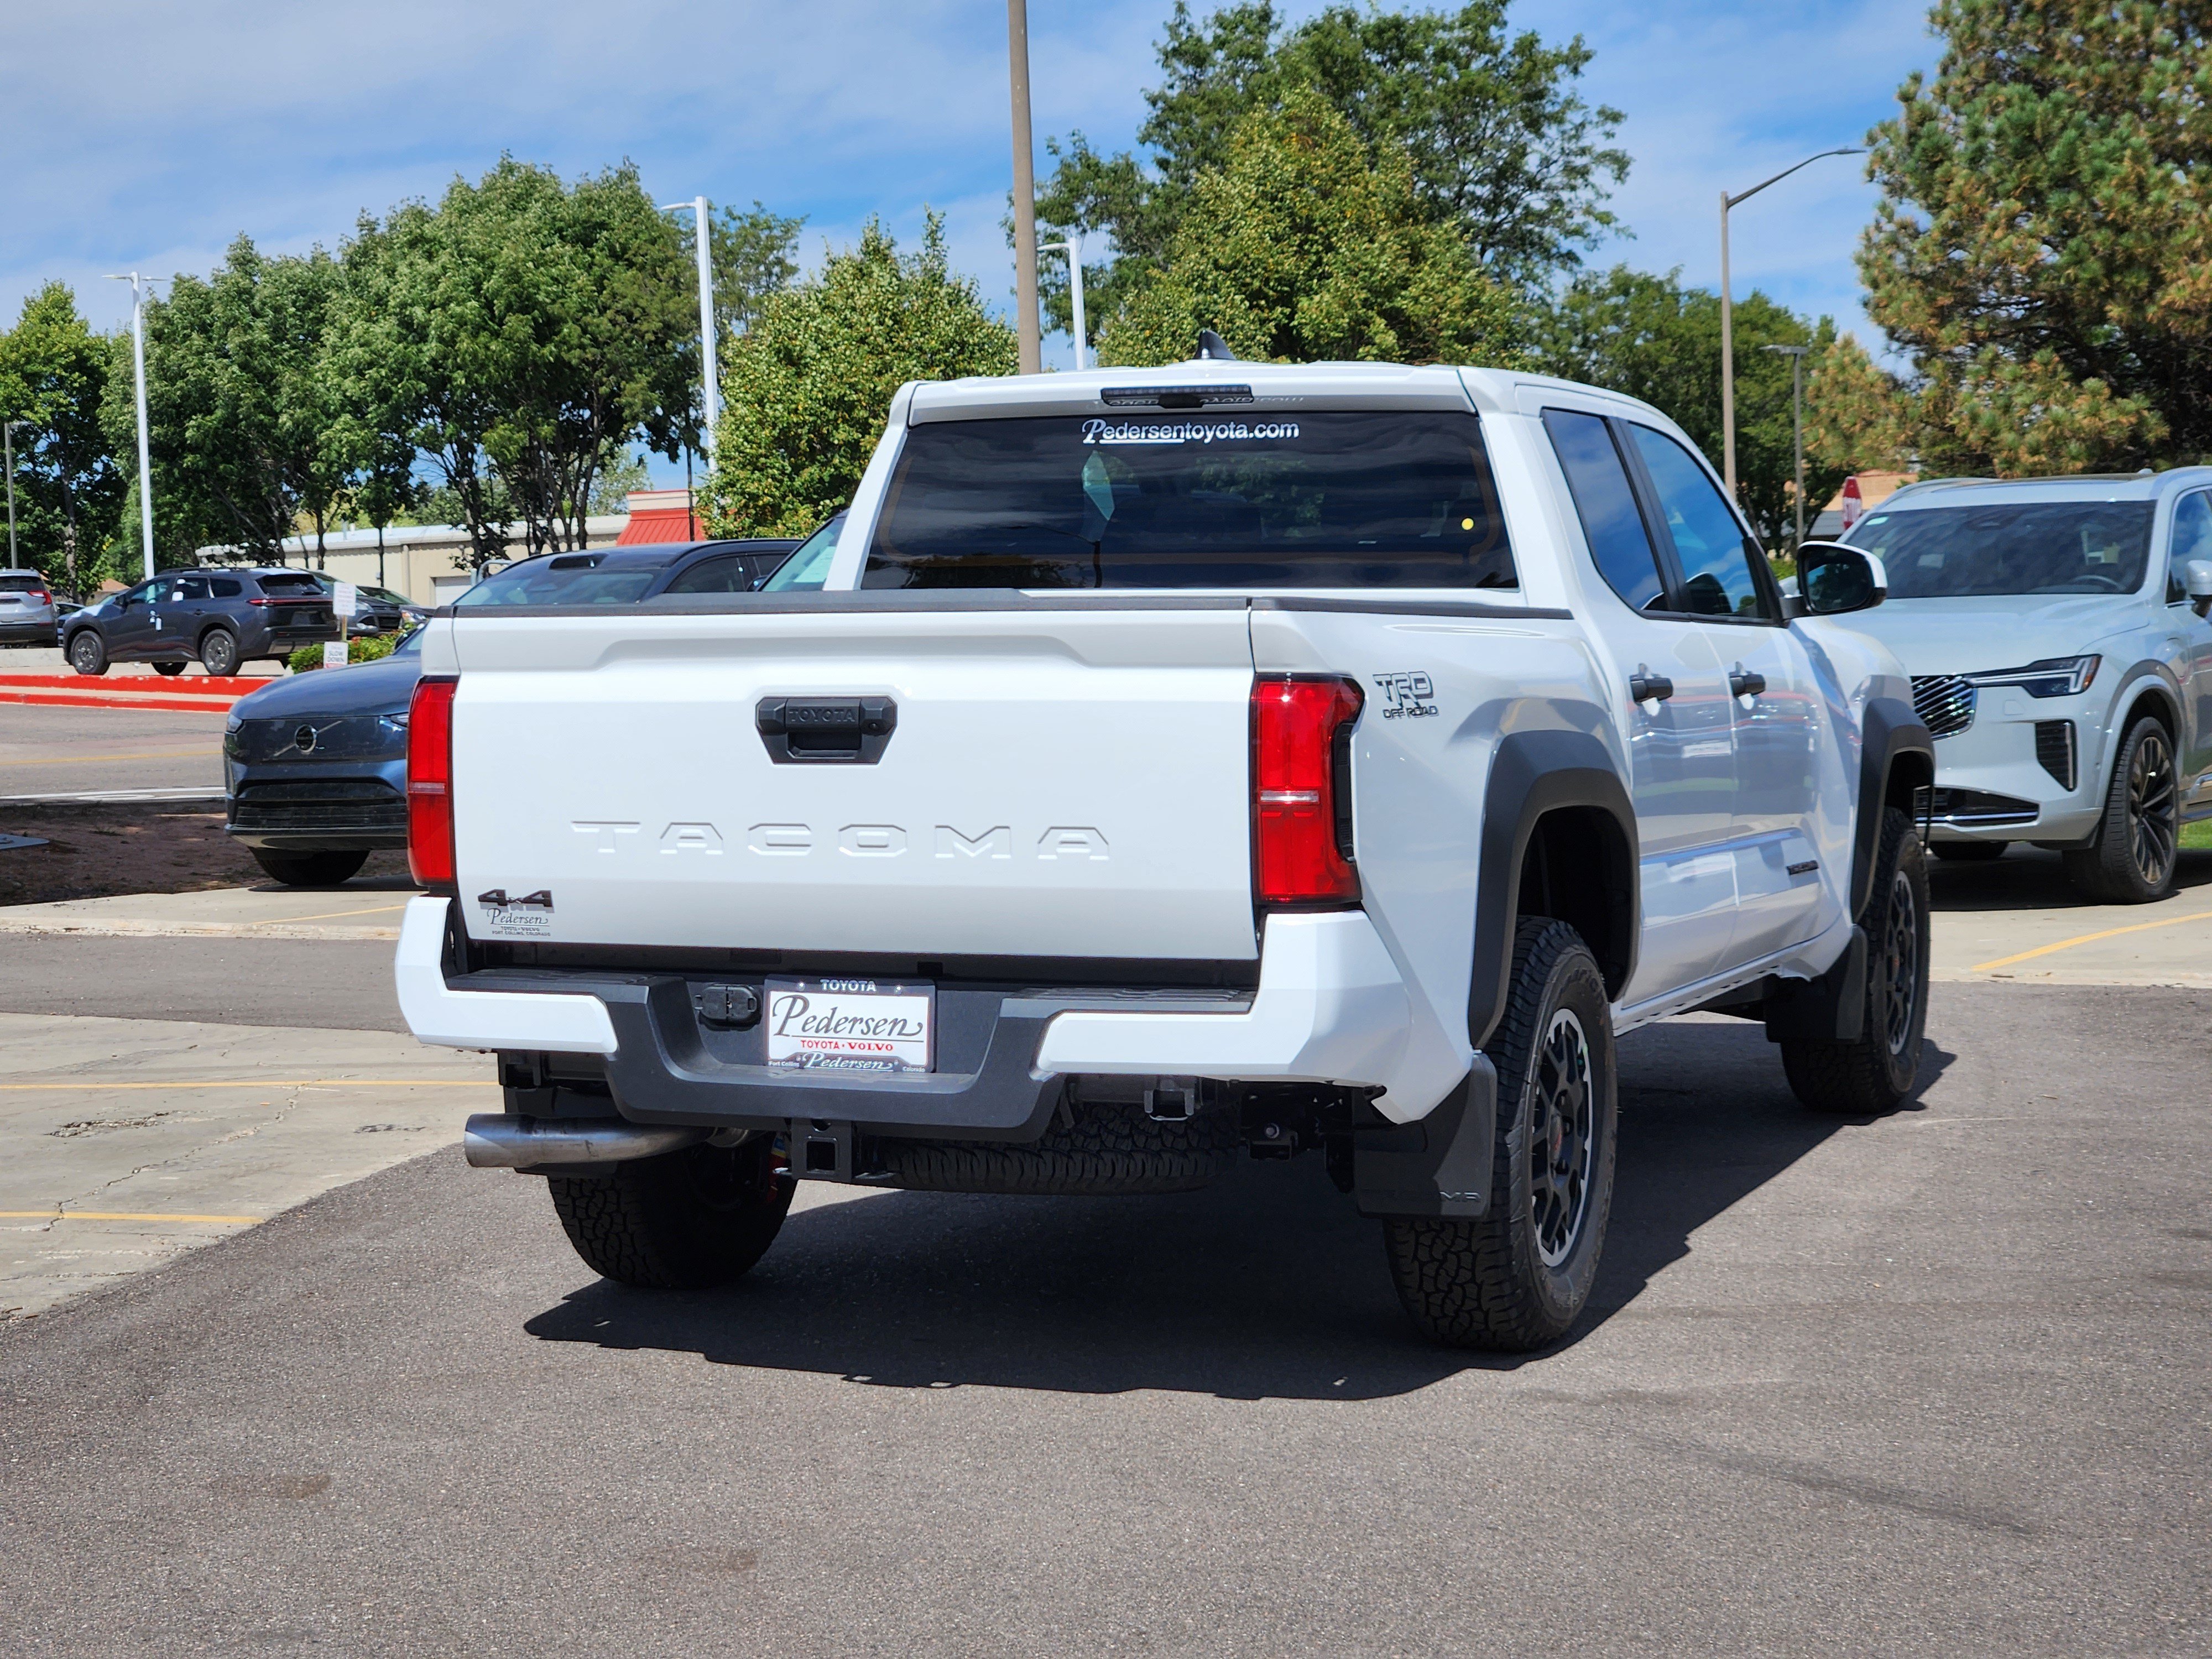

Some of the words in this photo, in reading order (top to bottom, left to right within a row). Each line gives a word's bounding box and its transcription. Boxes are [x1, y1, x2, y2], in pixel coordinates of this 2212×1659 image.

[1082, 419, 1300, 444] Pedersentoyota.com
[1373, 671, 1434, 707] TRD
[789, 709, 855, 722] TOYOTA
[1383, 708, 1405, 719] OFF
[1406, 706, 1439, 718] ROAD
[571, 821, 1109, 860] TACOMA
[487, 907, 549, 925] Pedersen
[819, 979, 877, 992] TOYOTA
[772, 994, 924, 1037] Pedersen
[801, 1040, 839, 1050] TOYOTA
[847, 1042, 894, 1051] VOLVO
[802, 1051, 893, 1070] Pedersen
